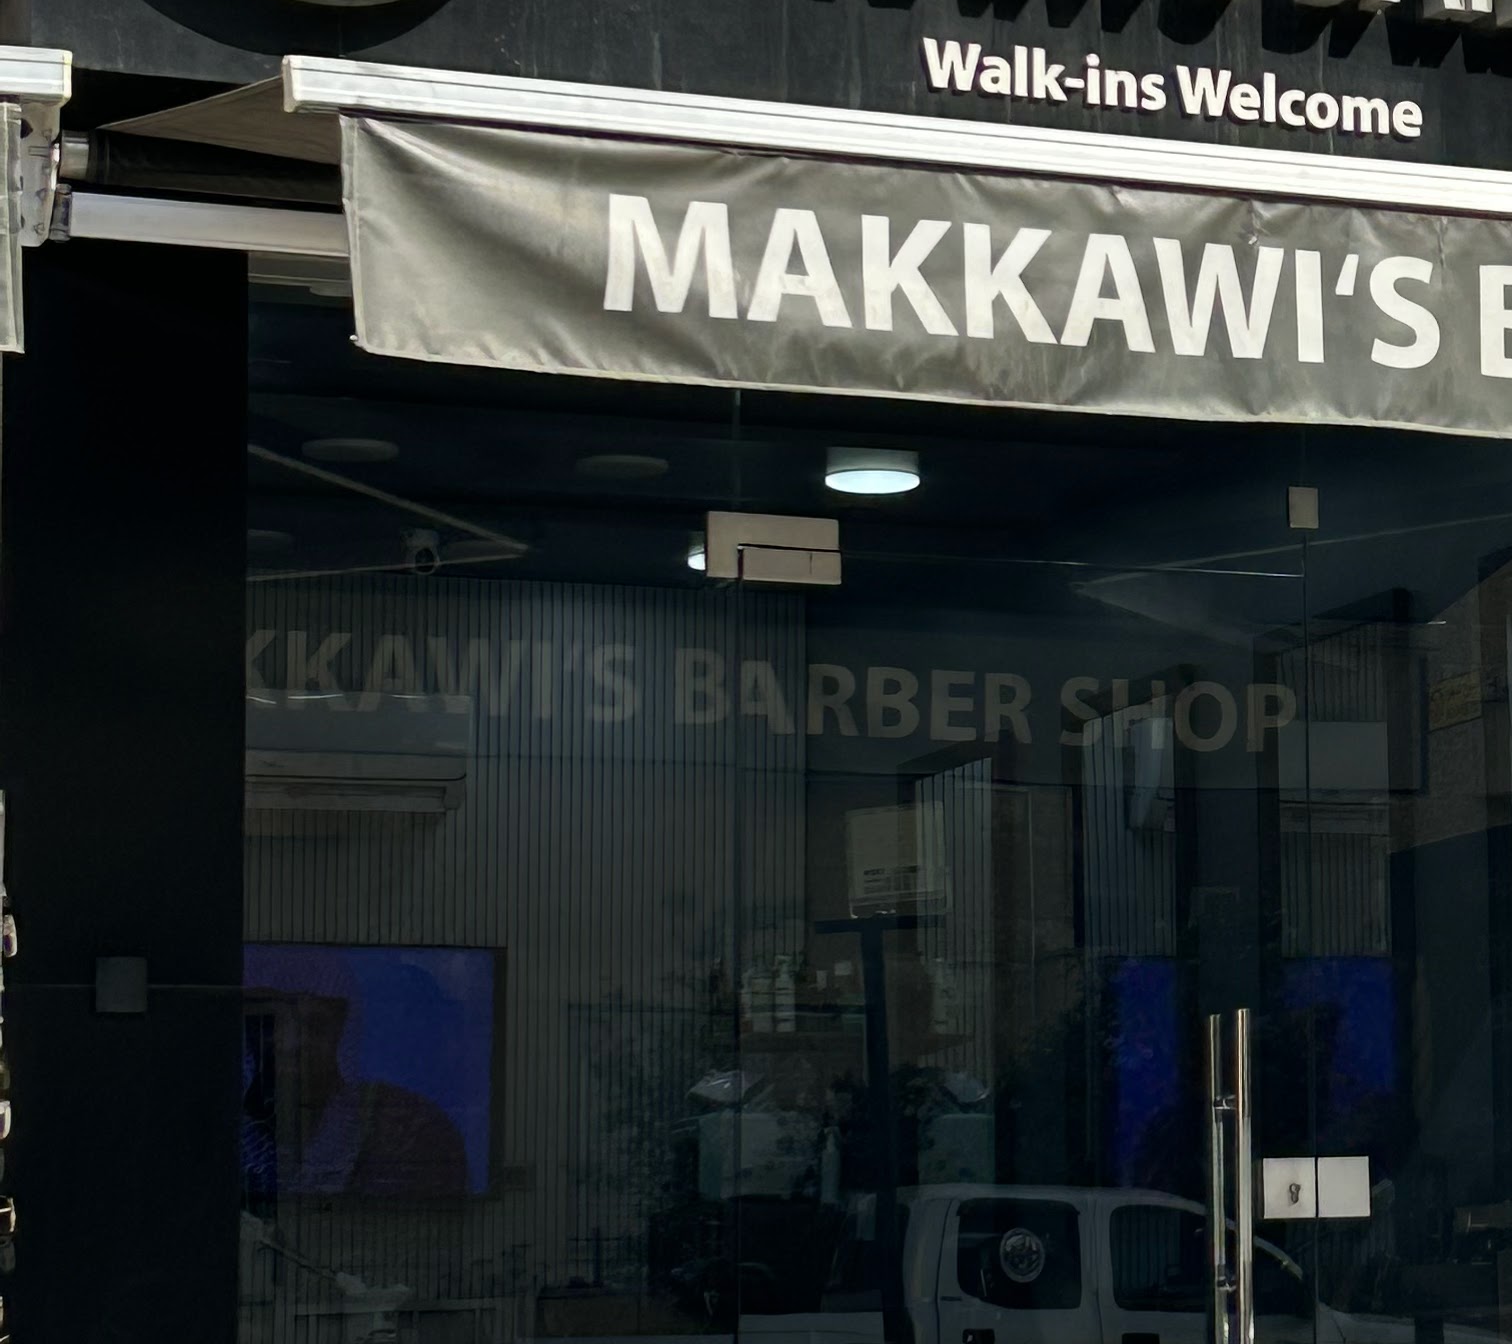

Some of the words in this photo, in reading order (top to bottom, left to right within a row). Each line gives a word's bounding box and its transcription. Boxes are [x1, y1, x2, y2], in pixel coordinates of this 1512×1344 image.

[922, 37, 1167, 112] Walk-ins
[1175, 65, 1423, 138] Welcome
[603, 193, 1441, 370] MAKKAWI'S
[675, 647, 1032, 743] BARBER
[1059, 676, 1297, 753] SHOP
